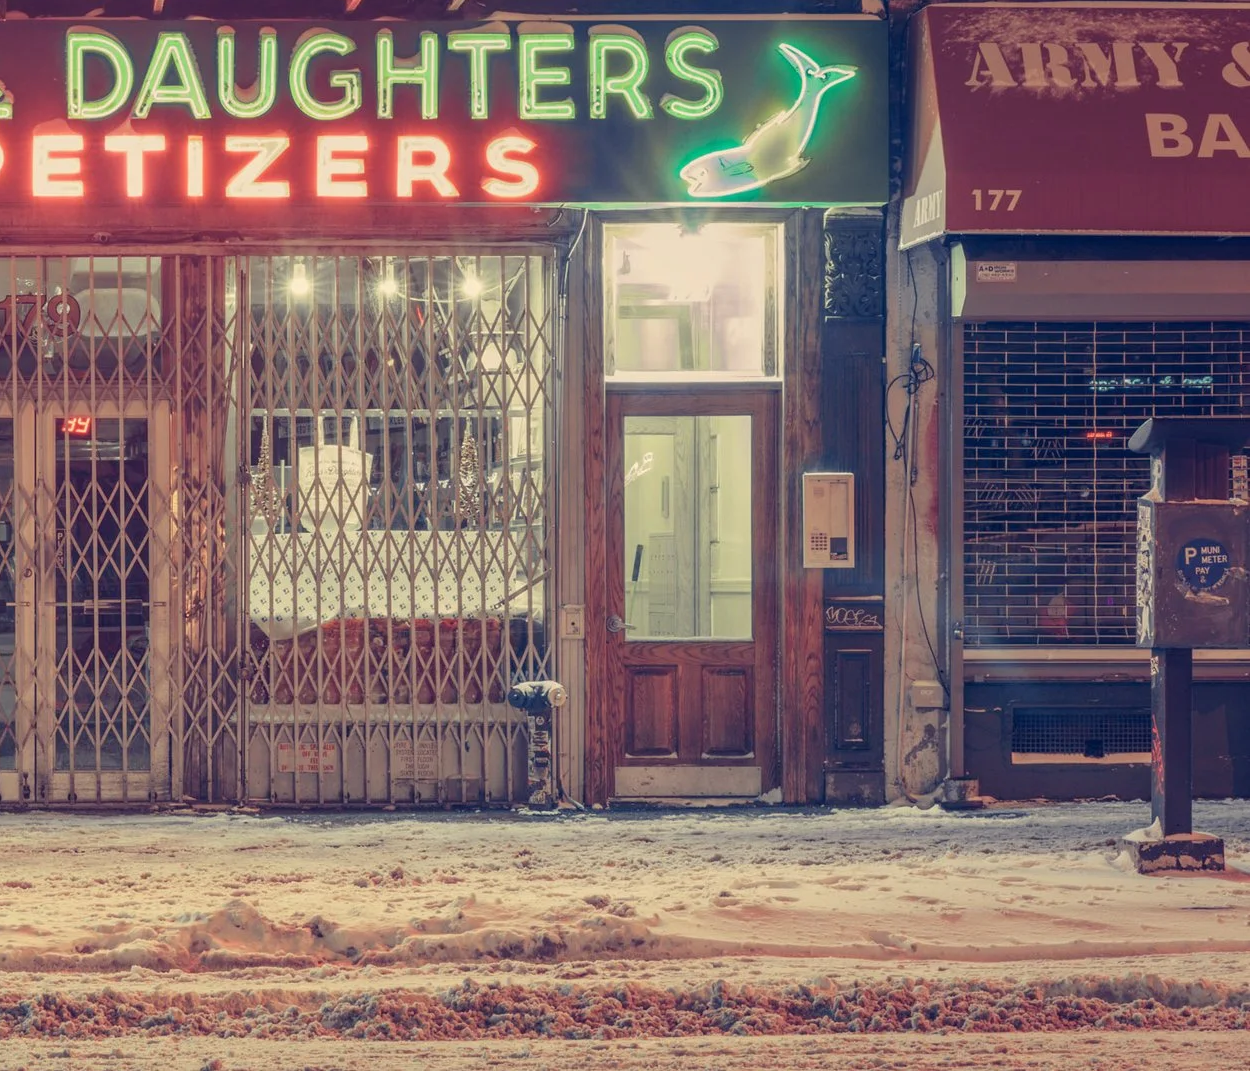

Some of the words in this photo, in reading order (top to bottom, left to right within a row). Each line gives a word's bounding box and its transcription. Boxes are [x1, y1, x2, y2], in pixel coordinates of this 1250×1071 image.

[965, 41, 1190, 88] ARMY
[66, 30, 724, 120] DAUGHTERS
[913, 190, 942, 228] ARMY
[971, 189, 1023, 211] 177
[1184, 547, 1197, 565] P
[1200, 546, 1220, 555] MUNI
[1201, 554, 1228, 564] METER
[1195, 566, 1210, 575] PAY
[1199, 575, 1207, 584] &
